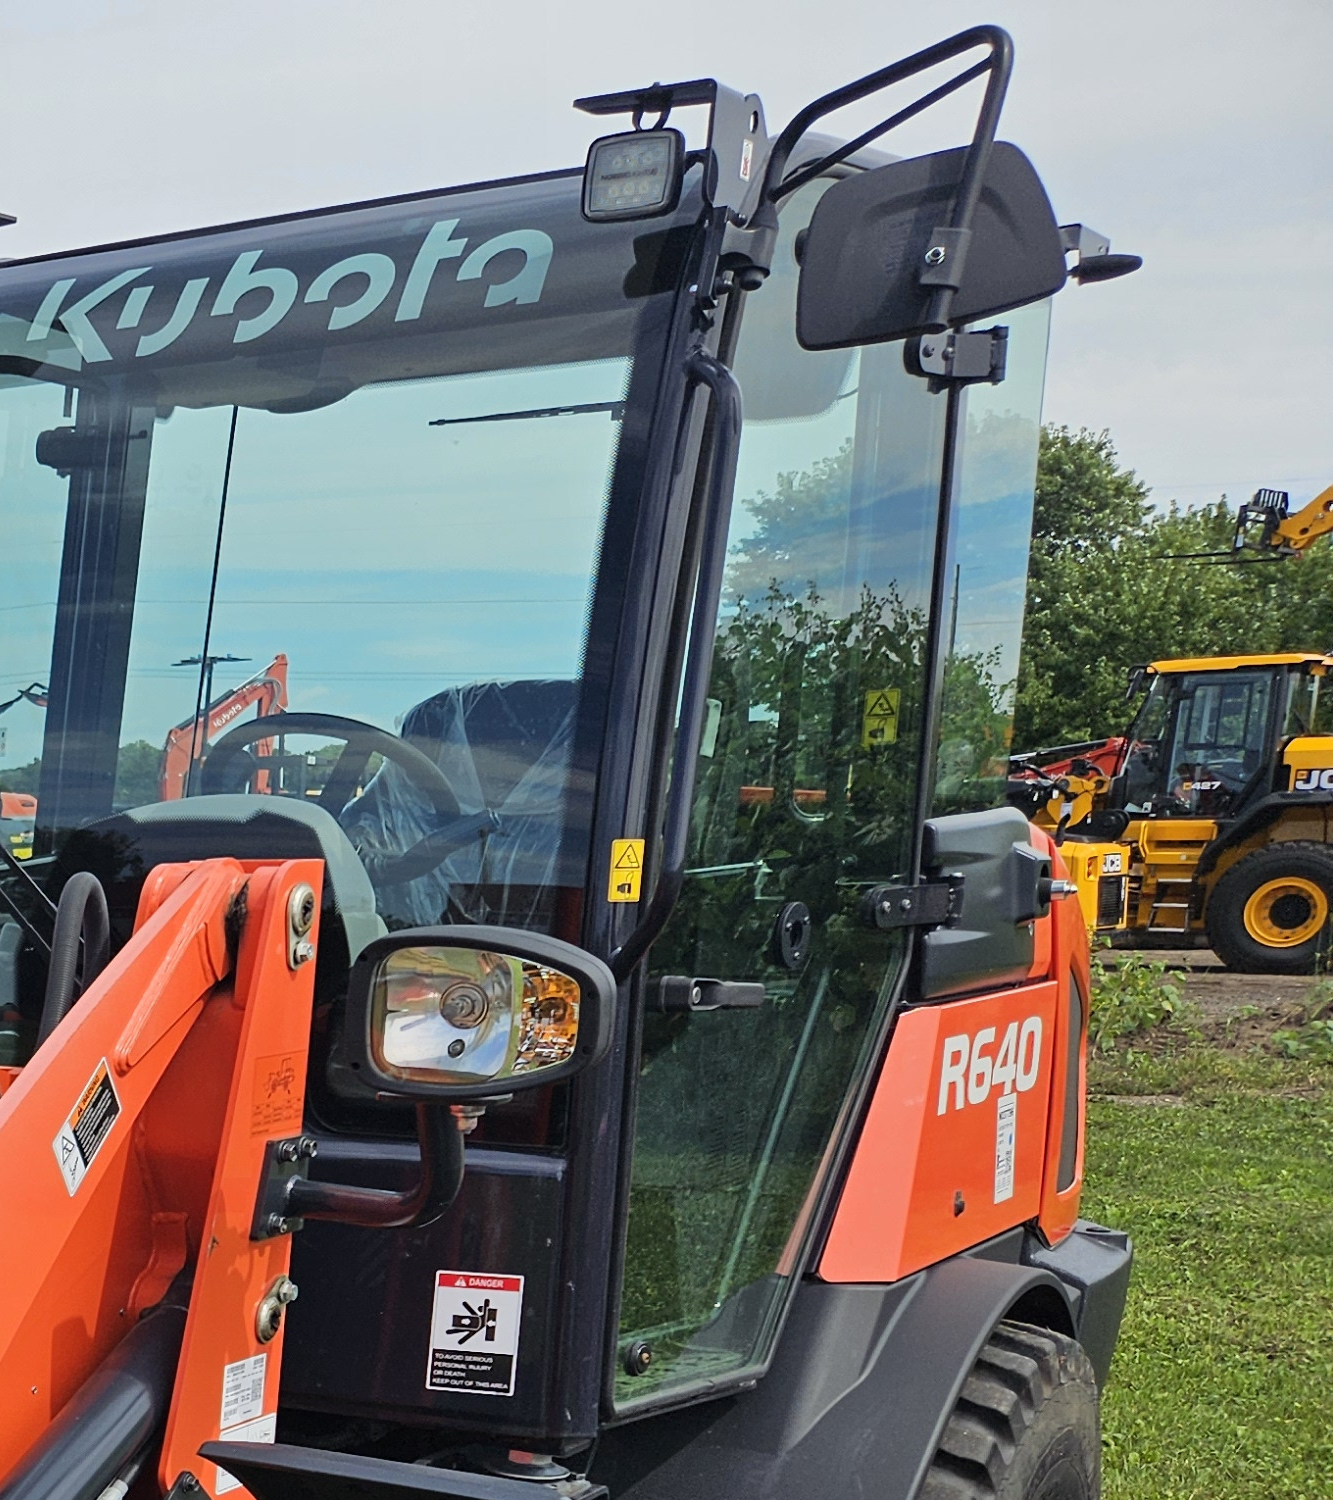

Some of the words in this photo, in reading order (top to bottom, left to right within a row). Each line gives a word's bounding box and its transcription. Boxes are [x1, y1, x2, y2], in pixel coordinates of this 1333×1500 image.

[26, 217, 555, 363] Kubota
[213, 703, 242, 728] Kubota
[1102, 854, 1122, 872] JCB
[937, 1014, 1043, 1116] R640
[468, 1277, 504, 1288] DANGER
[434, 1361, 467, 1370] PERSONAL
[468, 1363, 492, 1371] INJURY
[464, 1355, 493, 1363] SERIOUS
